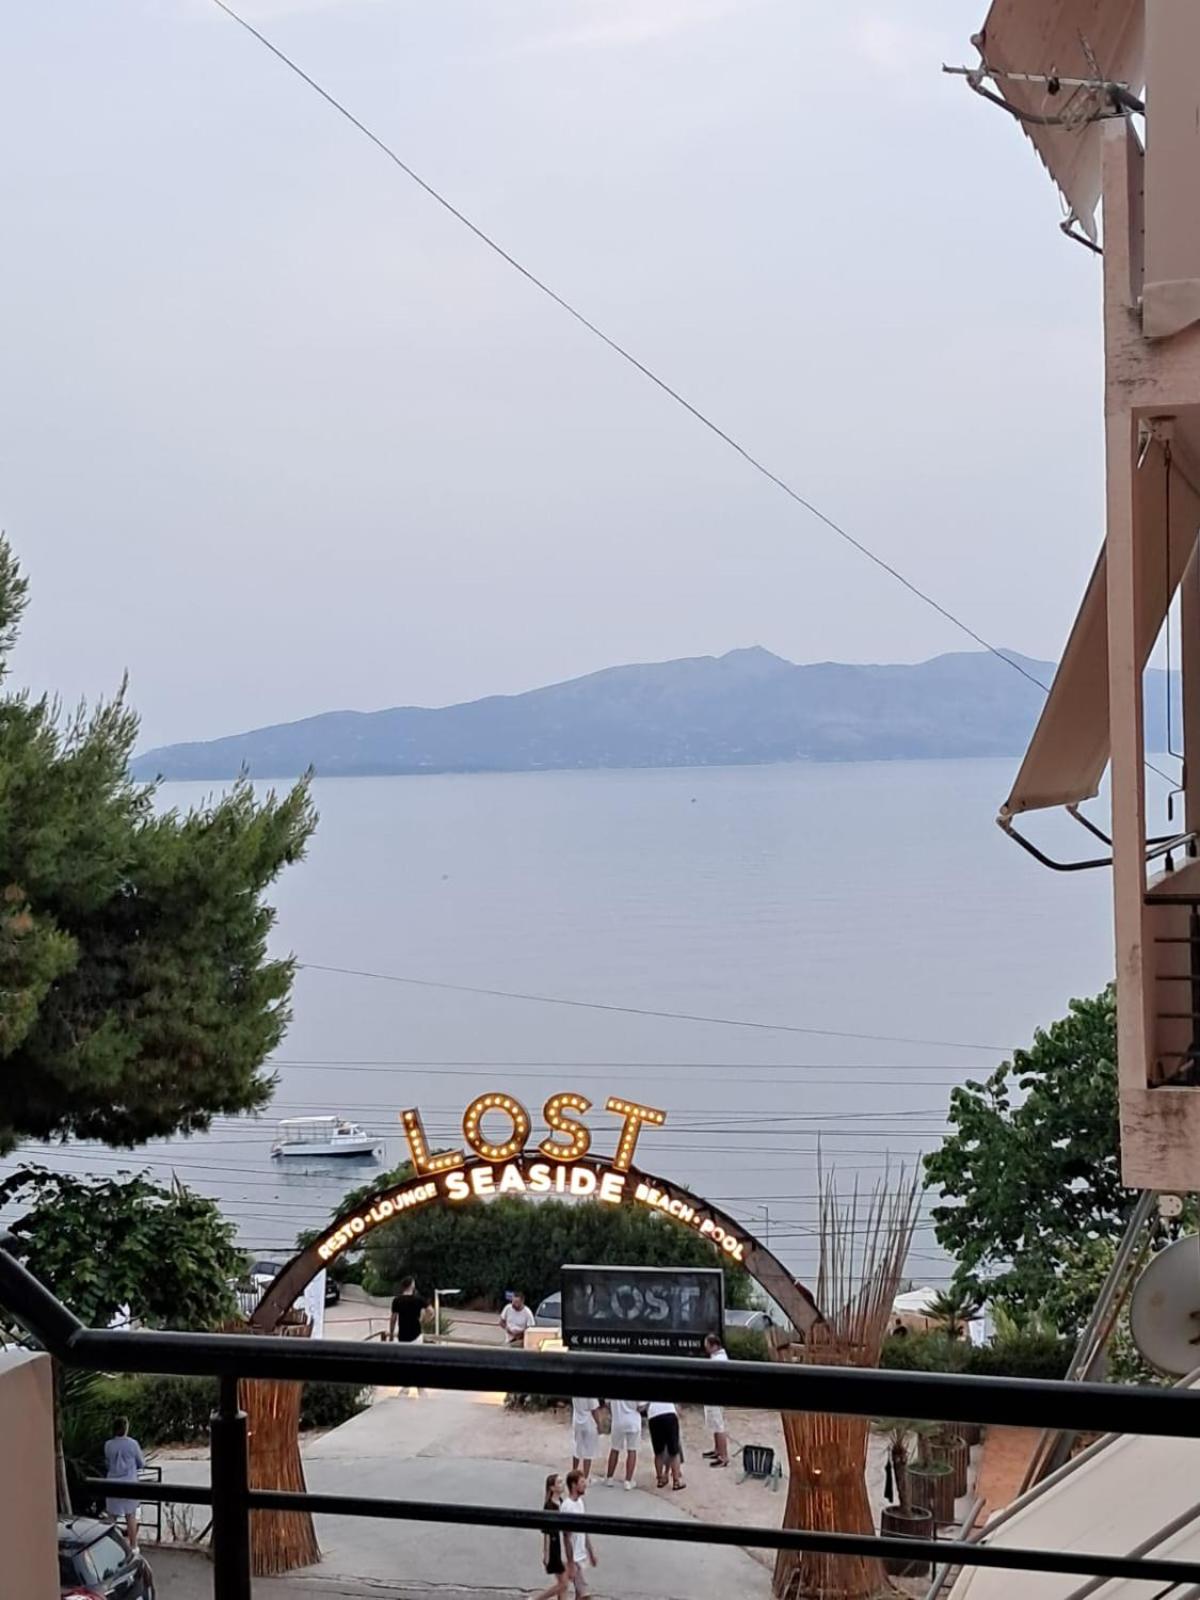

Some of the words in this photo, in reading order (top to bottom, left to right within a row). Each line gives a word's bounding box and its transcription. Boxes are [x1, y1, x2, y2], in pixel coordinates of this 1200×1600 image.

[399, 1092, 667, 1178] LOST
[445, 1163, 625, 1204] SEASIDE
[585, 1283, 700, 1320] LOST
[638, 1337, 671, 1347] LOUNGE
